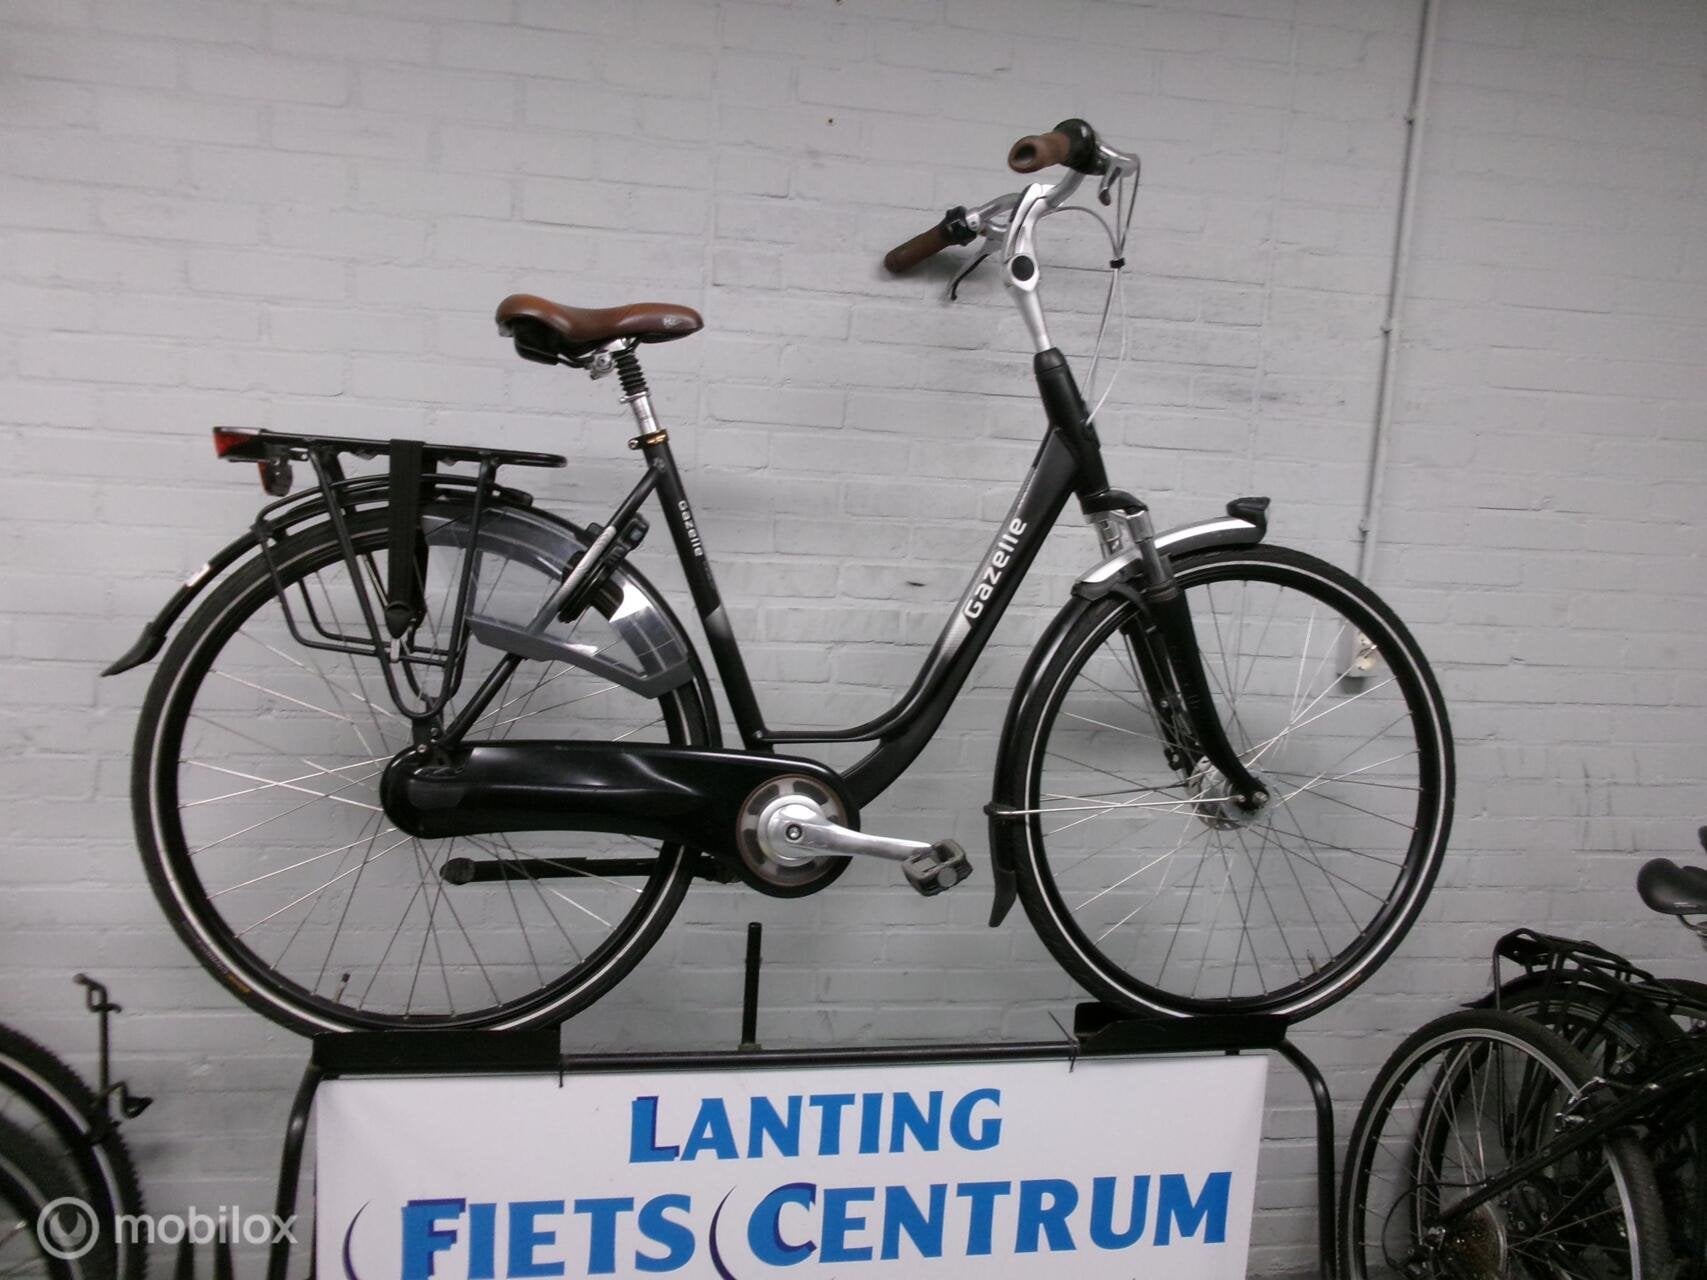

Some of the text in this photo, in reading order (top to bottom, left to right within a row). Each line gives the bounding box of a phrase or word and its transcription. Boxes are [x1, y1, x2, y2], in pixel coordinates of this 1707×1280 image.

[678, 500, 703, 556] Gazelle
[964, 517, 1028, 619] Gazelle
[629, 1087, 1003, 1163] LANTING
[400, 1171, 1230, 1280] FIETS CENTRUM
